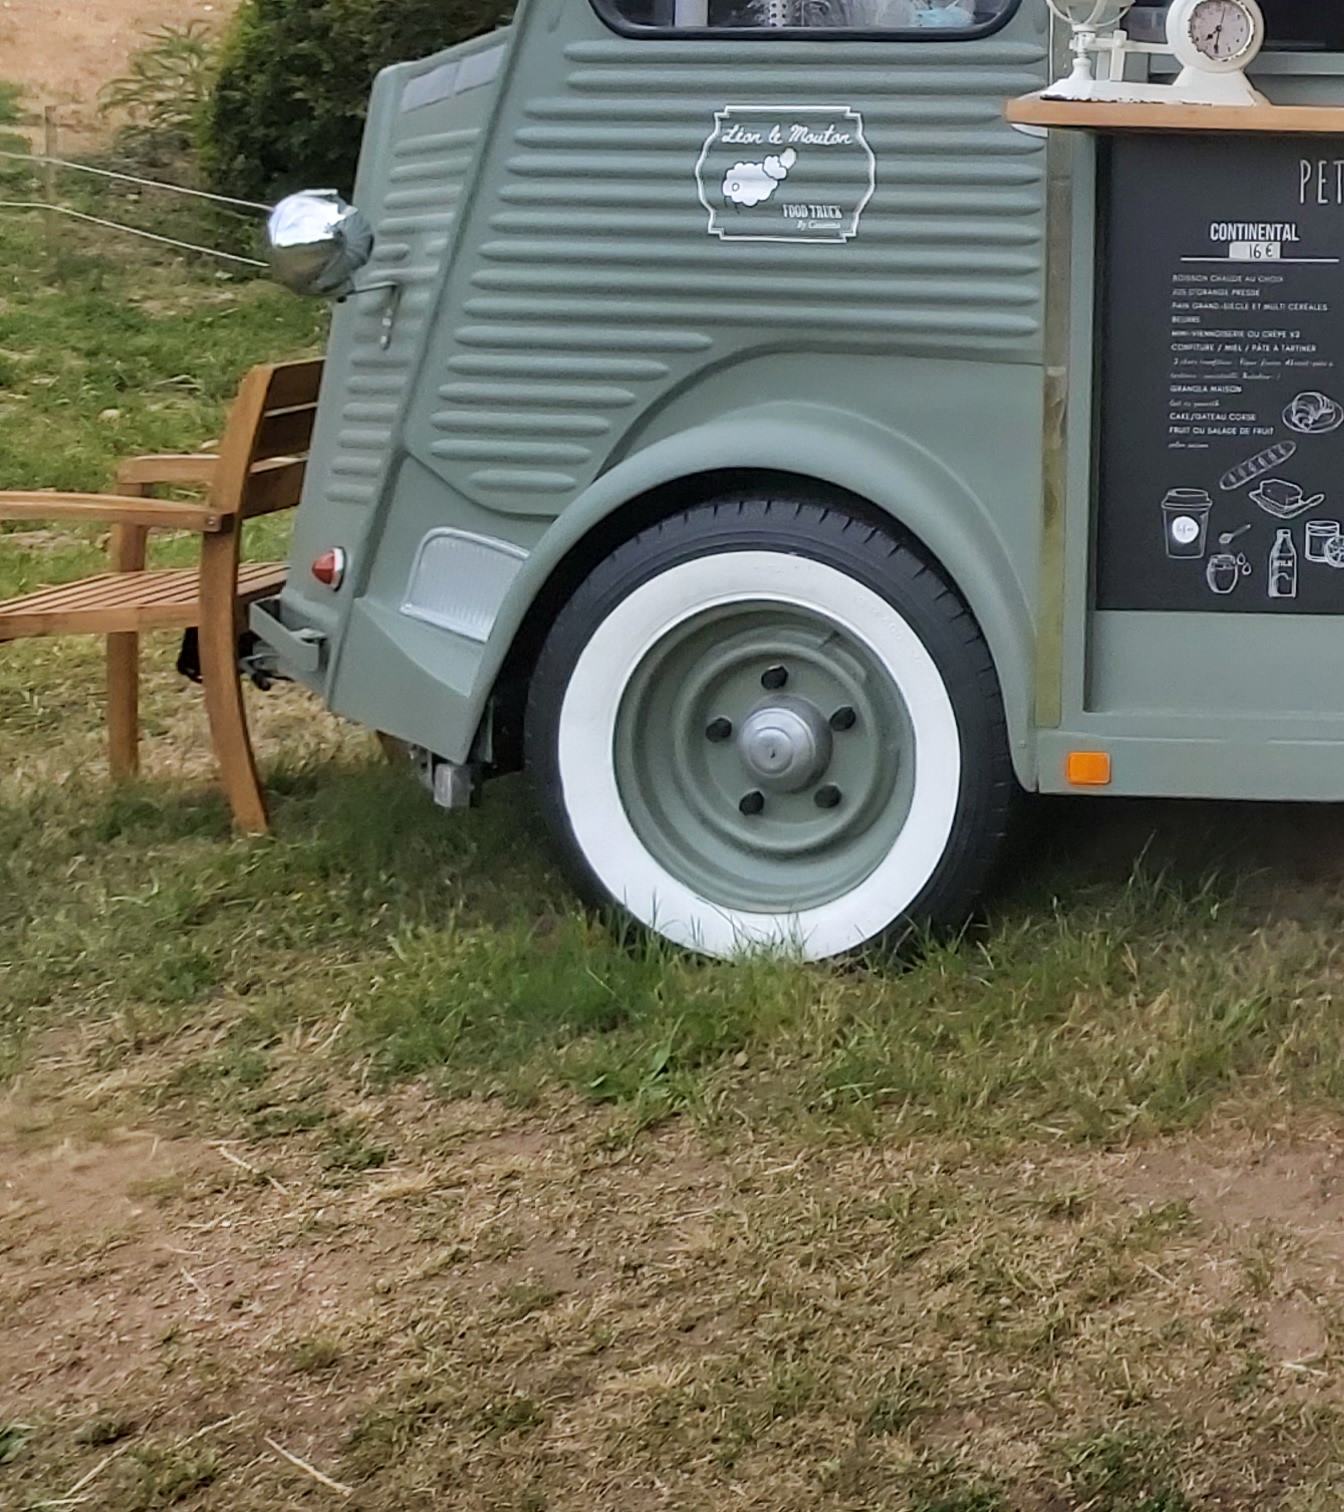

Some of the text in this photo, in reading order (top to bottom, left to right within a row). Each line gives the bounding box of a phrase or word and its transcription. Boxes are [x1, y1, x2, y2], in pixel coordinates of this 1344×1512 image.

[721, 123, 852, 145] Léon le Mouton
[782, 204, 842, 219] FOOD TRUCK
[1210, 222, 1300, 241] CONTINENTAL
